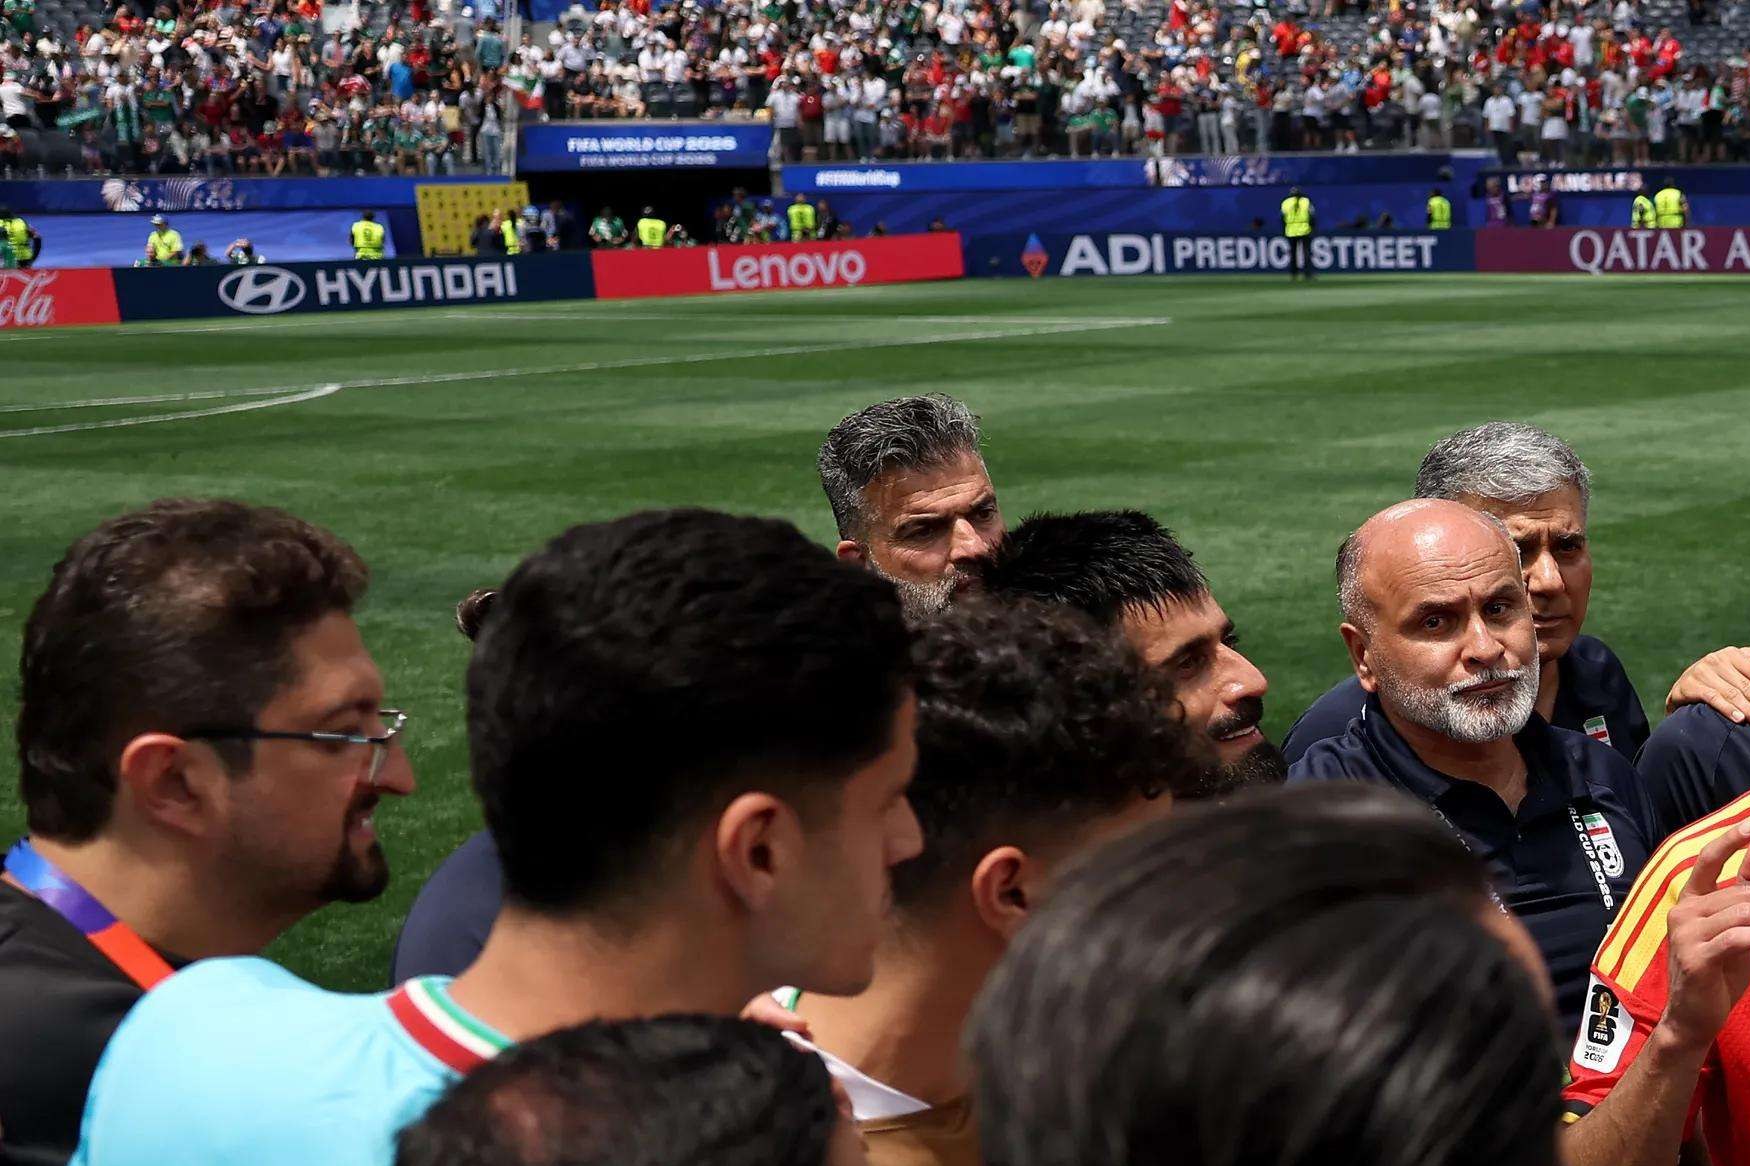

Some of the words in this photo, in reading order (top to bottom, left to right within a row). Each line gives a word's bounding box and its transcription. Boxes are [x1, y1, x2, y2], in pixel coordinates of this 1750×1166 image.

[567, 137, 600, 152] FIFA
[601, 137, 654, 151] WORLD
[655, 136, 685, 151] CUP
[1508, 174, 1548, 193] LOS
[1551, 172, 1643, 192] ANGELES
[708, 248, 866, 291] Lenovo
[1060, 233, 1167, 276] ADI
[1569, 229, 1709, 276] QATAR
[316, 262, 517, 305] HYUNDAI
[1579, 833, 1596, 859] CUP
